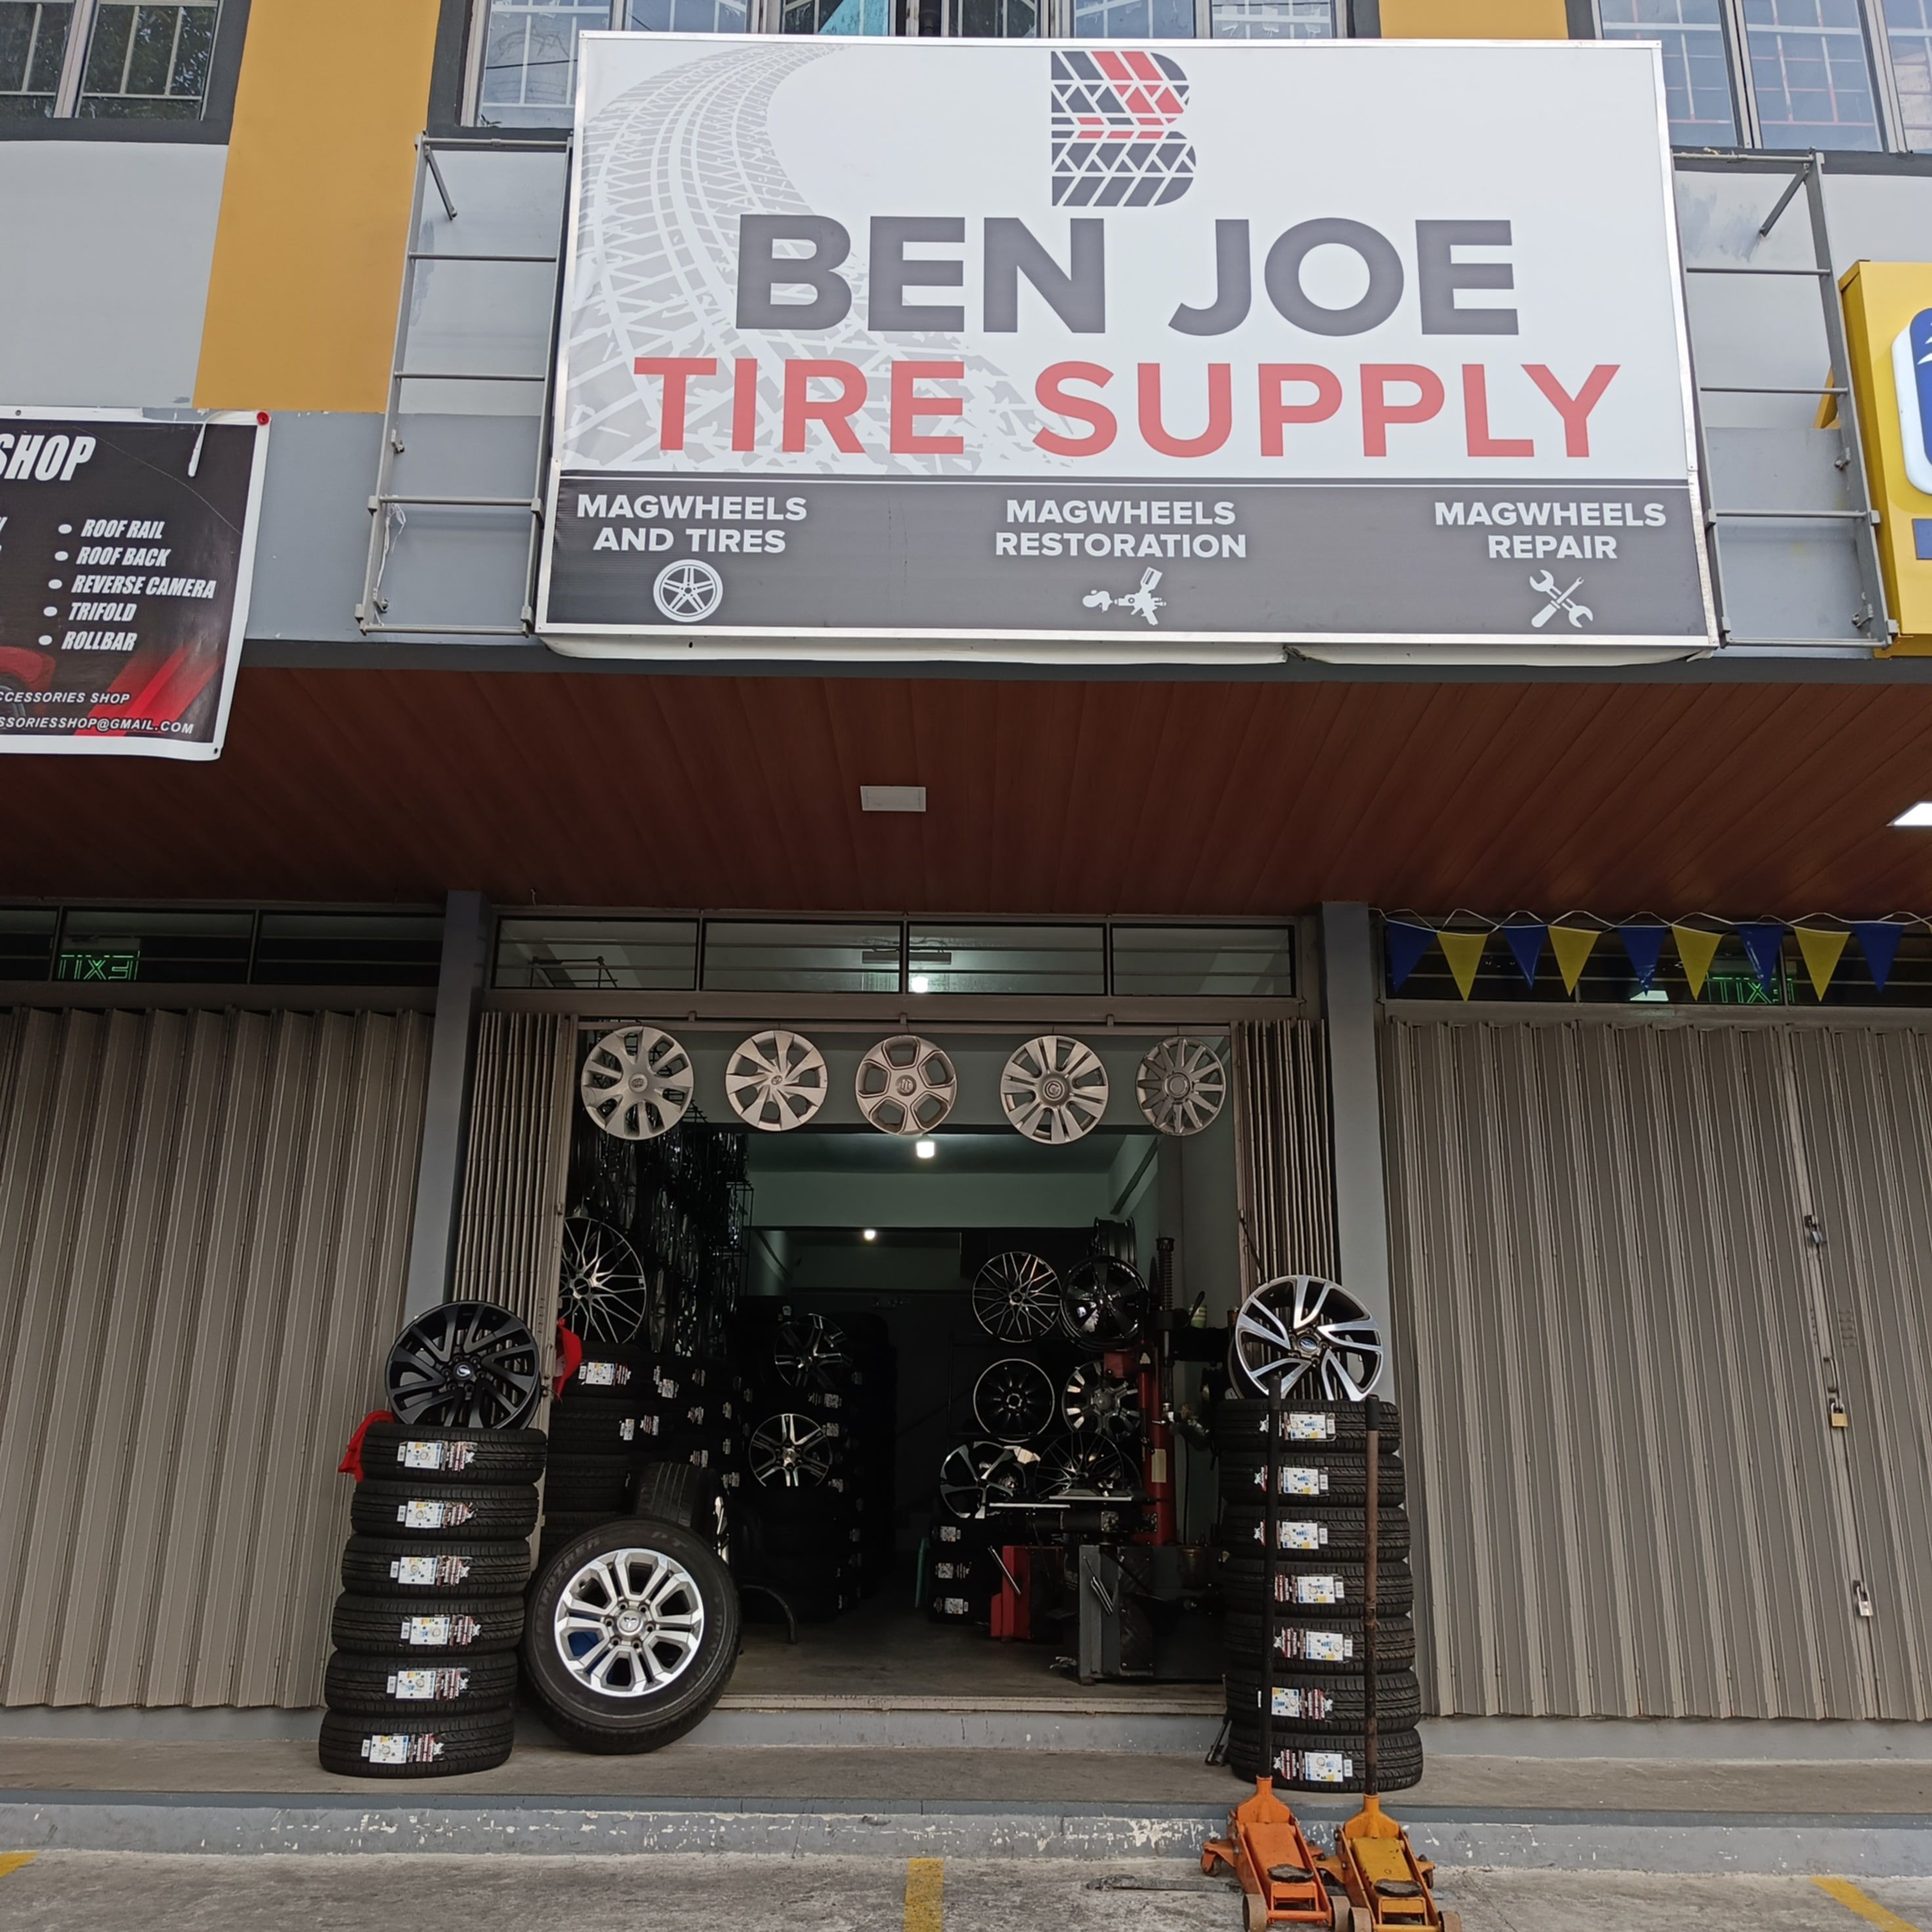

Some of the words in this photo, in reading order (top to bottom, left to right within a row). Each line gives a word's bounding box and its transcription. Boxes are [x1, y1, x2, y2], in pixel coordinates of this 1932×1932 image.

[736, 215, 1105, 333] BEN
[1168, 217, 1519, 337] JOE
[634, 358, 964, 455] TIRE
[1034, 362, 1619, 458] SUPPLY
[577, 494, 807, 521] MAGWHEELS
[1007, 499, 1236, 525] MAGWHEELS
[1435, 501, 1667, 527] MAGWHEELS
[81, 519, 128, 537] ROOF
[127, 520, 165, 539] RAIL
[593, 527, 674, 551] AND
[685, 528, 786, 553] TIRES
[75, 546, 123, 565] ROOF
[122, 547, 171, 567] BACK
[996, 532, 1246, 558] RESTORATION
[1488, 535, 1618, 559] REPAIR
[71, 575, 146, 595] REVERSE
[145, 576, 217, 599] CAMERA
[68, 602, 137, 621] TRIFOLD
[61, 631, 138, 651] ROLLBAR
[90, 692, 131, 704] SHOP
